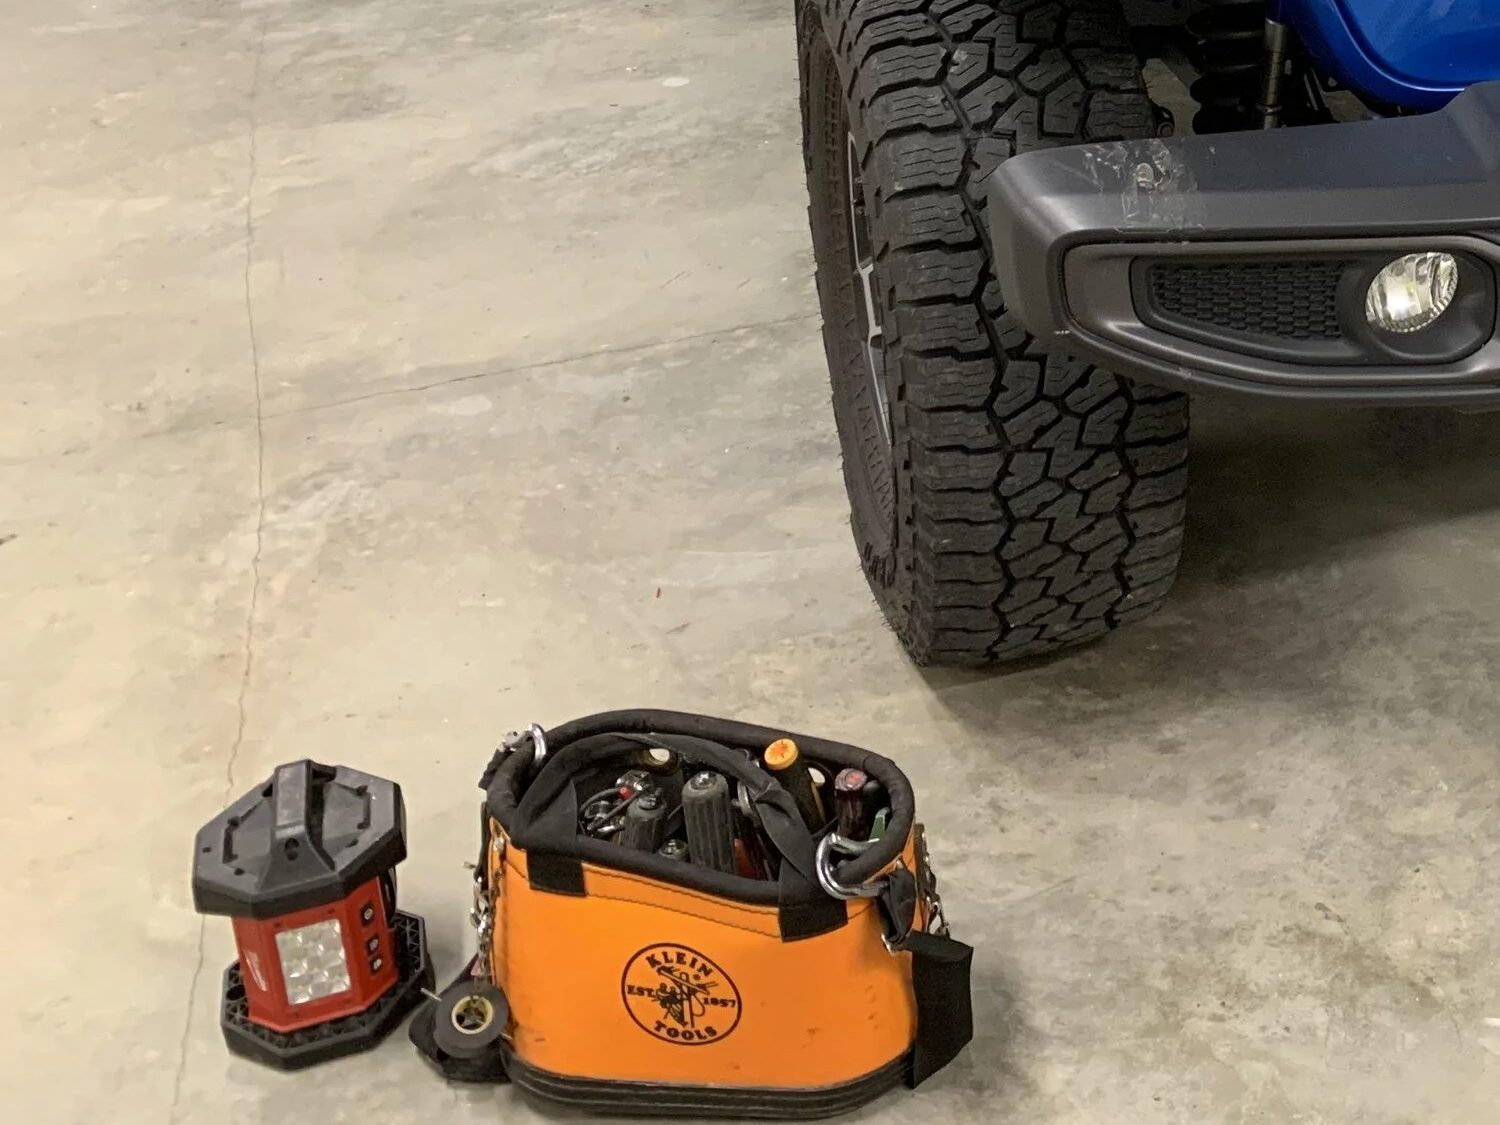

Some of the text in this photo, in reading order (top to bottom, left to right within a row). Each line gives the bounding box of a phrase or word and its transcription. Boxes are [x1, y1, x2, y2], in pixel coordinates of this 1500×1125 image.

[645, 951, 713, 977] KLEIN
[702, 997, 736, 1009] 1857
[653, 1020, 718, 1041] TOOLS
